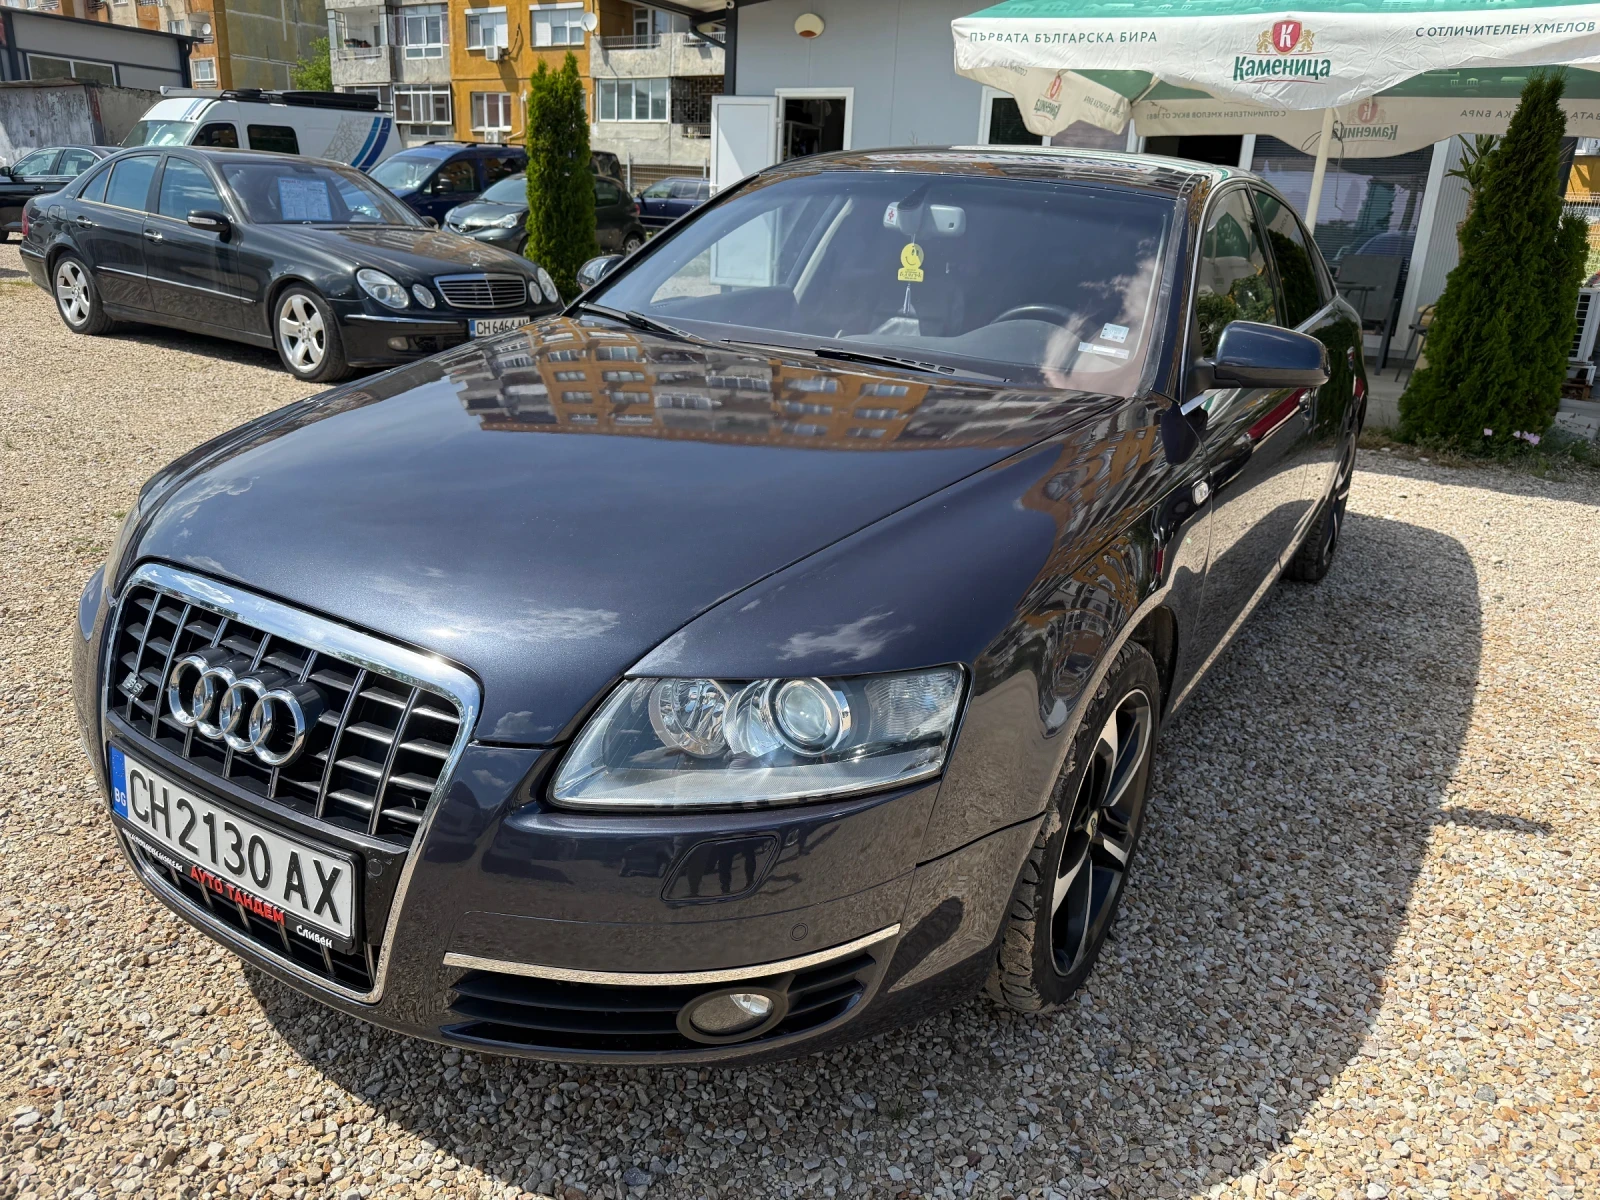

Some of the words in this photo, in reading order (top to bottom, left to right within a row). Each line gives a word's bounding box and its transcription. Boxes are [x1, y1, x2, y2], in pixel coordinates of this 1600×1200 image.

[969, 32, 1030, 43] ПЪРВАТА
[1034, 32, 1114, 44] БЪЛГАРСКА
[1119, 31, 1158, 43] БИРА
[1415, 27, 1425, 37] С
[1427, 24, 1530, 37] ОТЛИЧИТЕЛЕН
[1532, 21, 1596, 34] ХМЕЛОВ
[1232, 56, 1332, 81] Каменица
[114, 786, 127, 807] BG
[283, 850, 342, 926] AX
[225, 883, 286, 926] ТАНДЕМ
